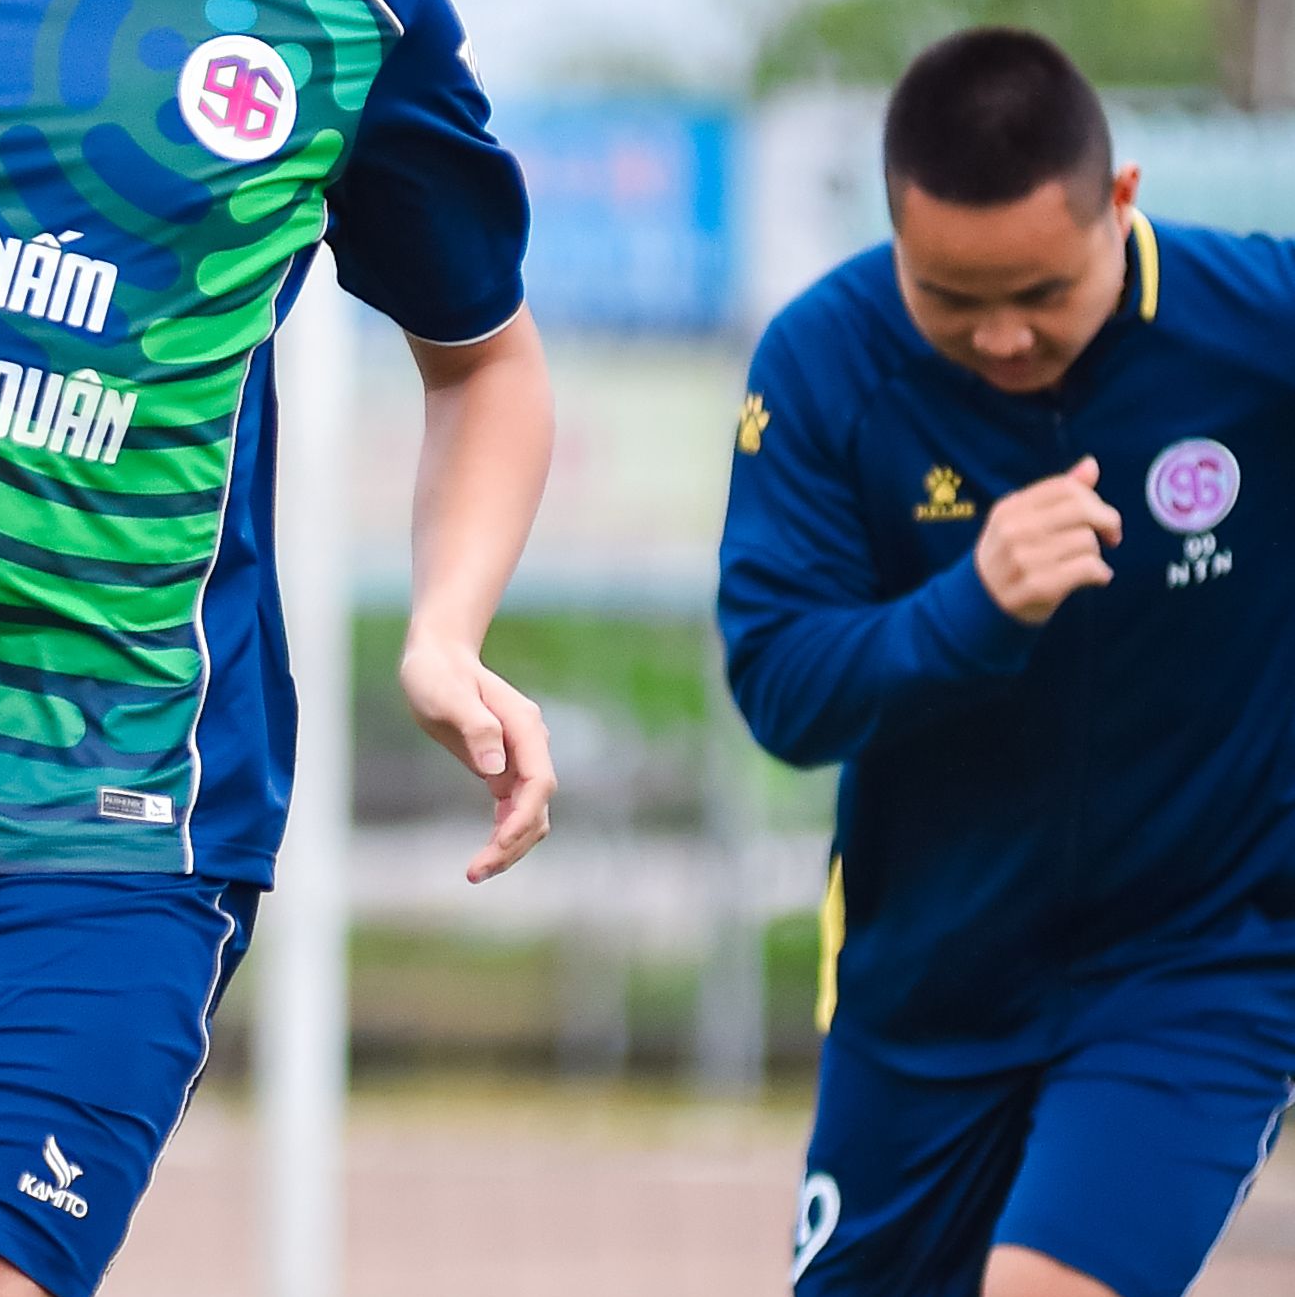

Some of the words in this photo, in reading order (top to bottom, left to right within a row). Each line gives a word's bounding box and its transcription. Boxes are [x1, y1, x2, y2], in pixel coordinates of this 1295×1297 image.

[198, 54, 284, 141] 96
[1168, 459, 1221, 516] 96
[17, 1171, 88, 1218] KAMITO
